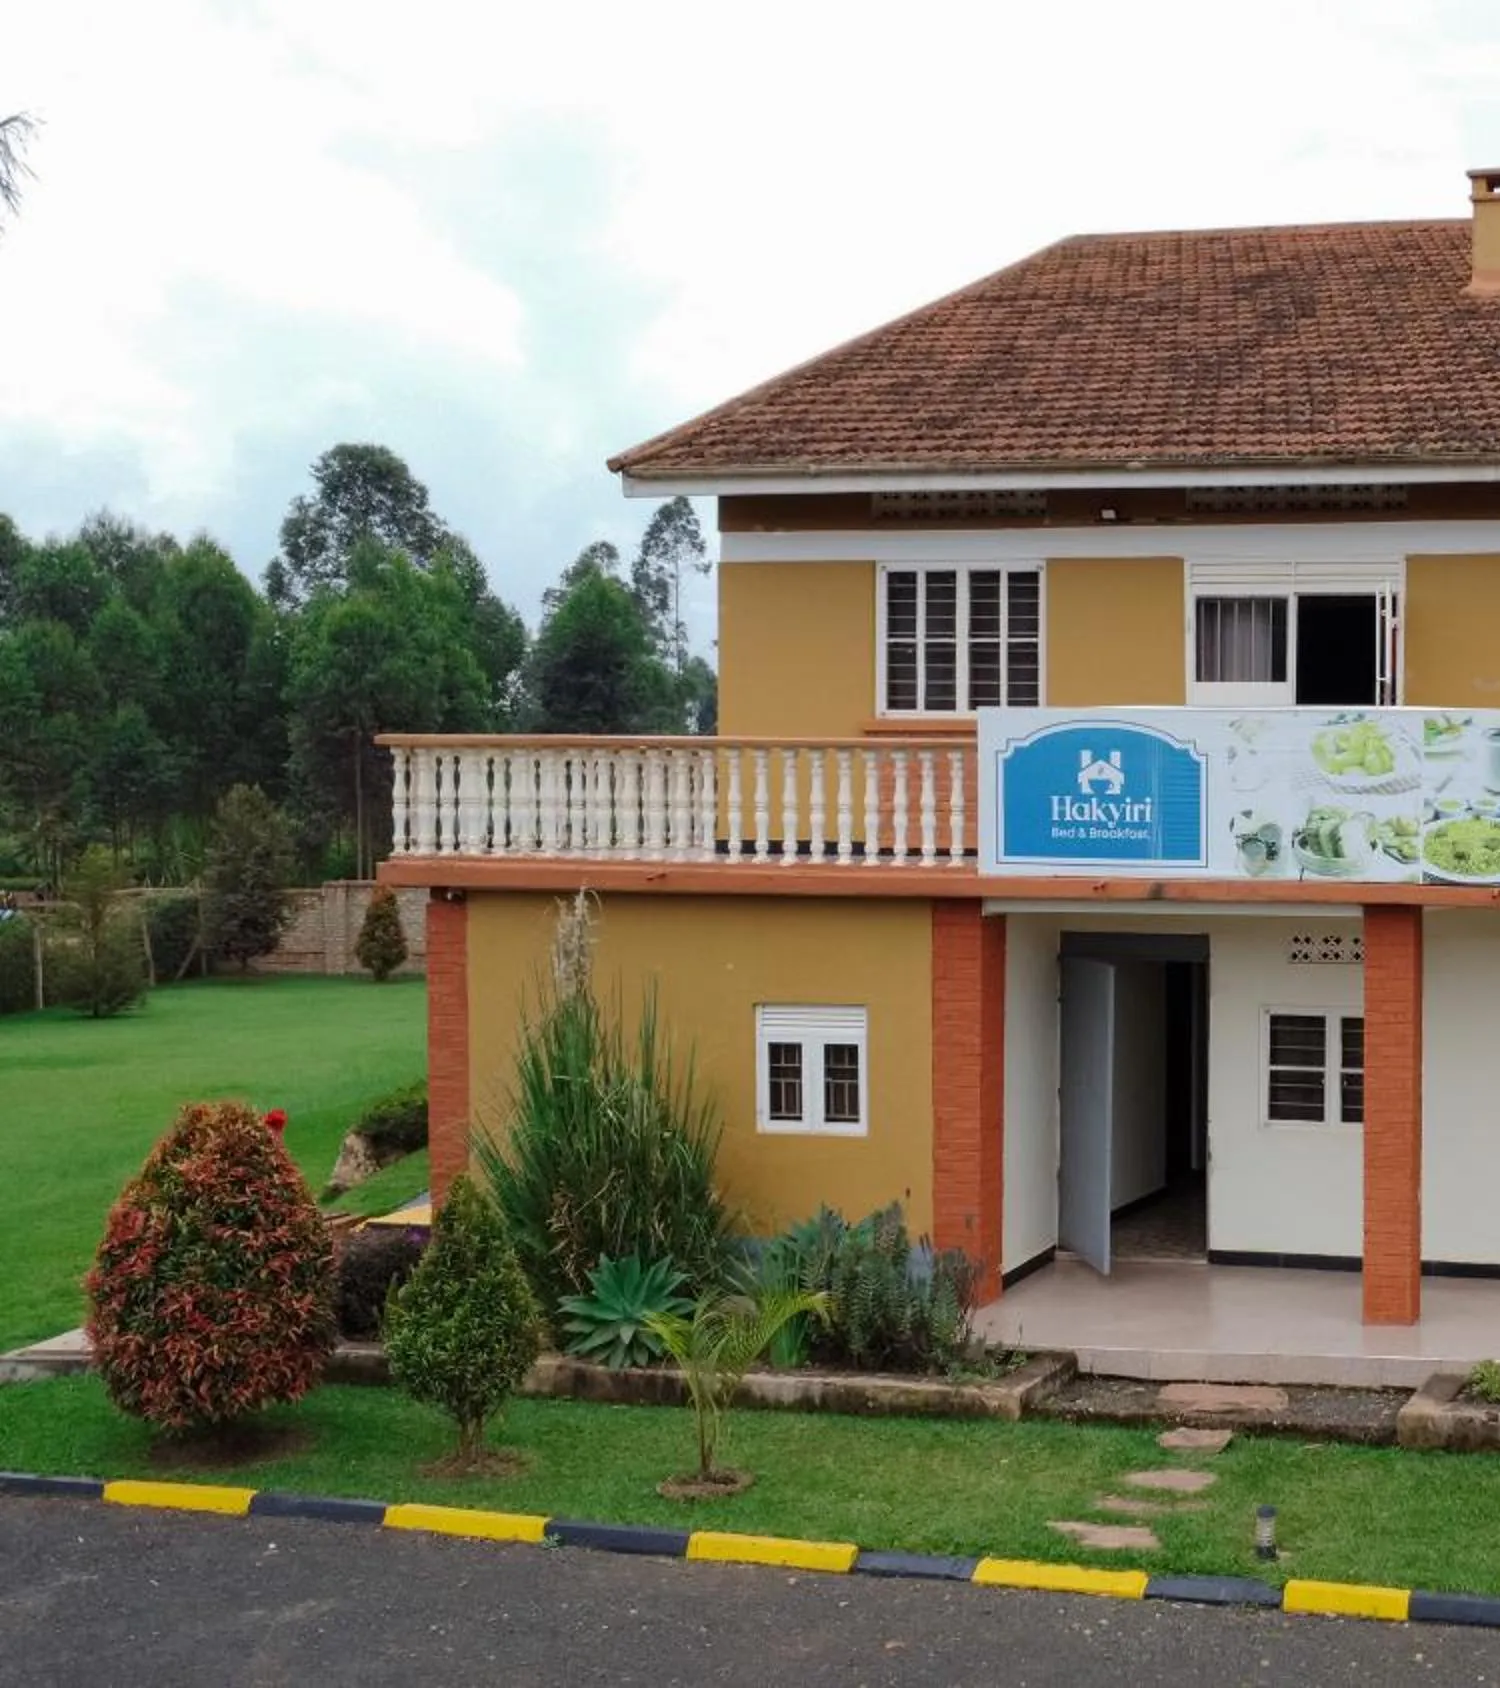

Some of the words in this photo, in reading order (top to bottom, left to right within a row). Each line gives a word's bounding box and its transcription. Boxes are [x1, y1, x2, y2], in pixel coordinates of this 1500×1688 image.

[1050, 795, 1152, 828] Hakyiri
[1051, 827, 1075, 838] Bed
[1078, 827, 1087, 838] &
